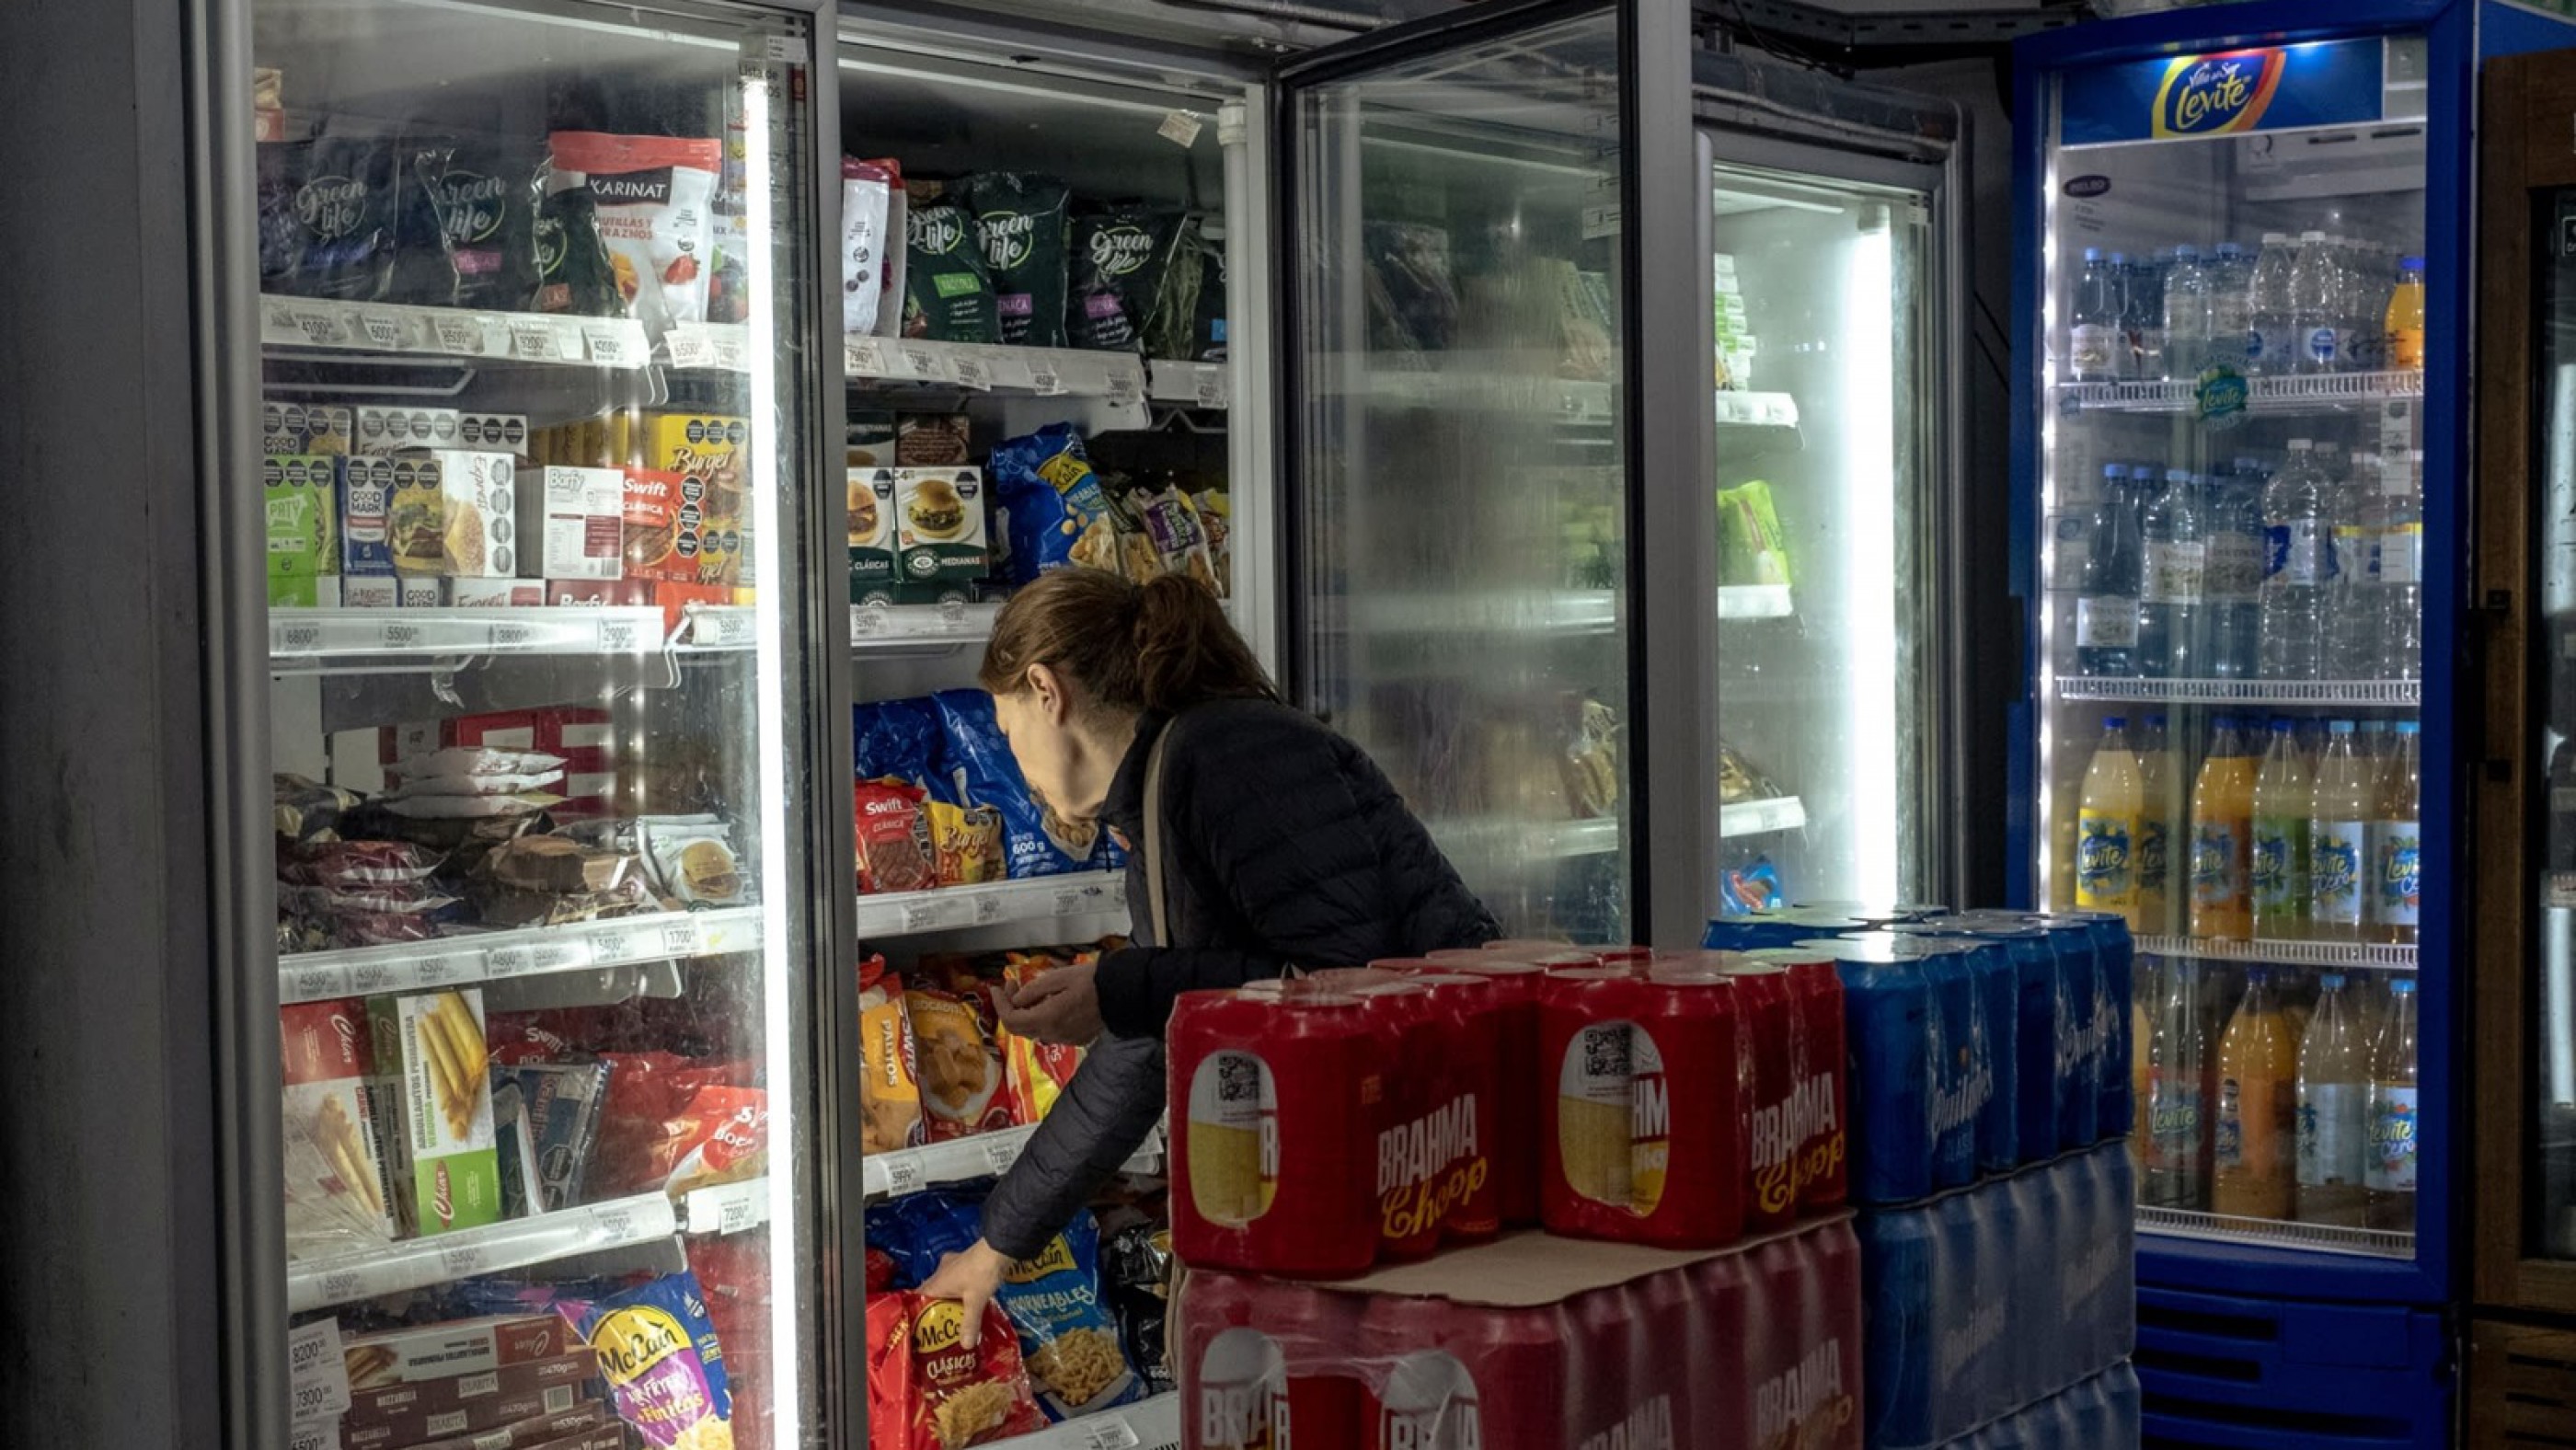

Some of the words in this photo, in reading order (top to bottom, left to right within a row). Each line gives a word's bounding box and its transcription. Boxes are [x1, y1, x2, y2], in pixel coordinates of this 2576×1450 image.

[296, 180, 367, 224] Green
[590, 178, 668, 199] KARINAT
[926, 220, 957, 256] life
[989, 236, 1023, 271] life
[1090, 231, 1154, 266] Green
[671, 447, 730, 478] Burger
[351, 490, 383, 502] GOOD
[624, 478, 668, 497] Swift
[866, 800, 903, 816] Swift
[1013, 840, 1036, 855] 600
[880, 1018, 898, 1087] PALITOS
[1377, 1093, 1478, 1196] BRAHMA
[293, 1341, 318, 1364] 8200
[599, 1327, 680, 1375] McCain
[296, 1387, 323, 1408] 7300
